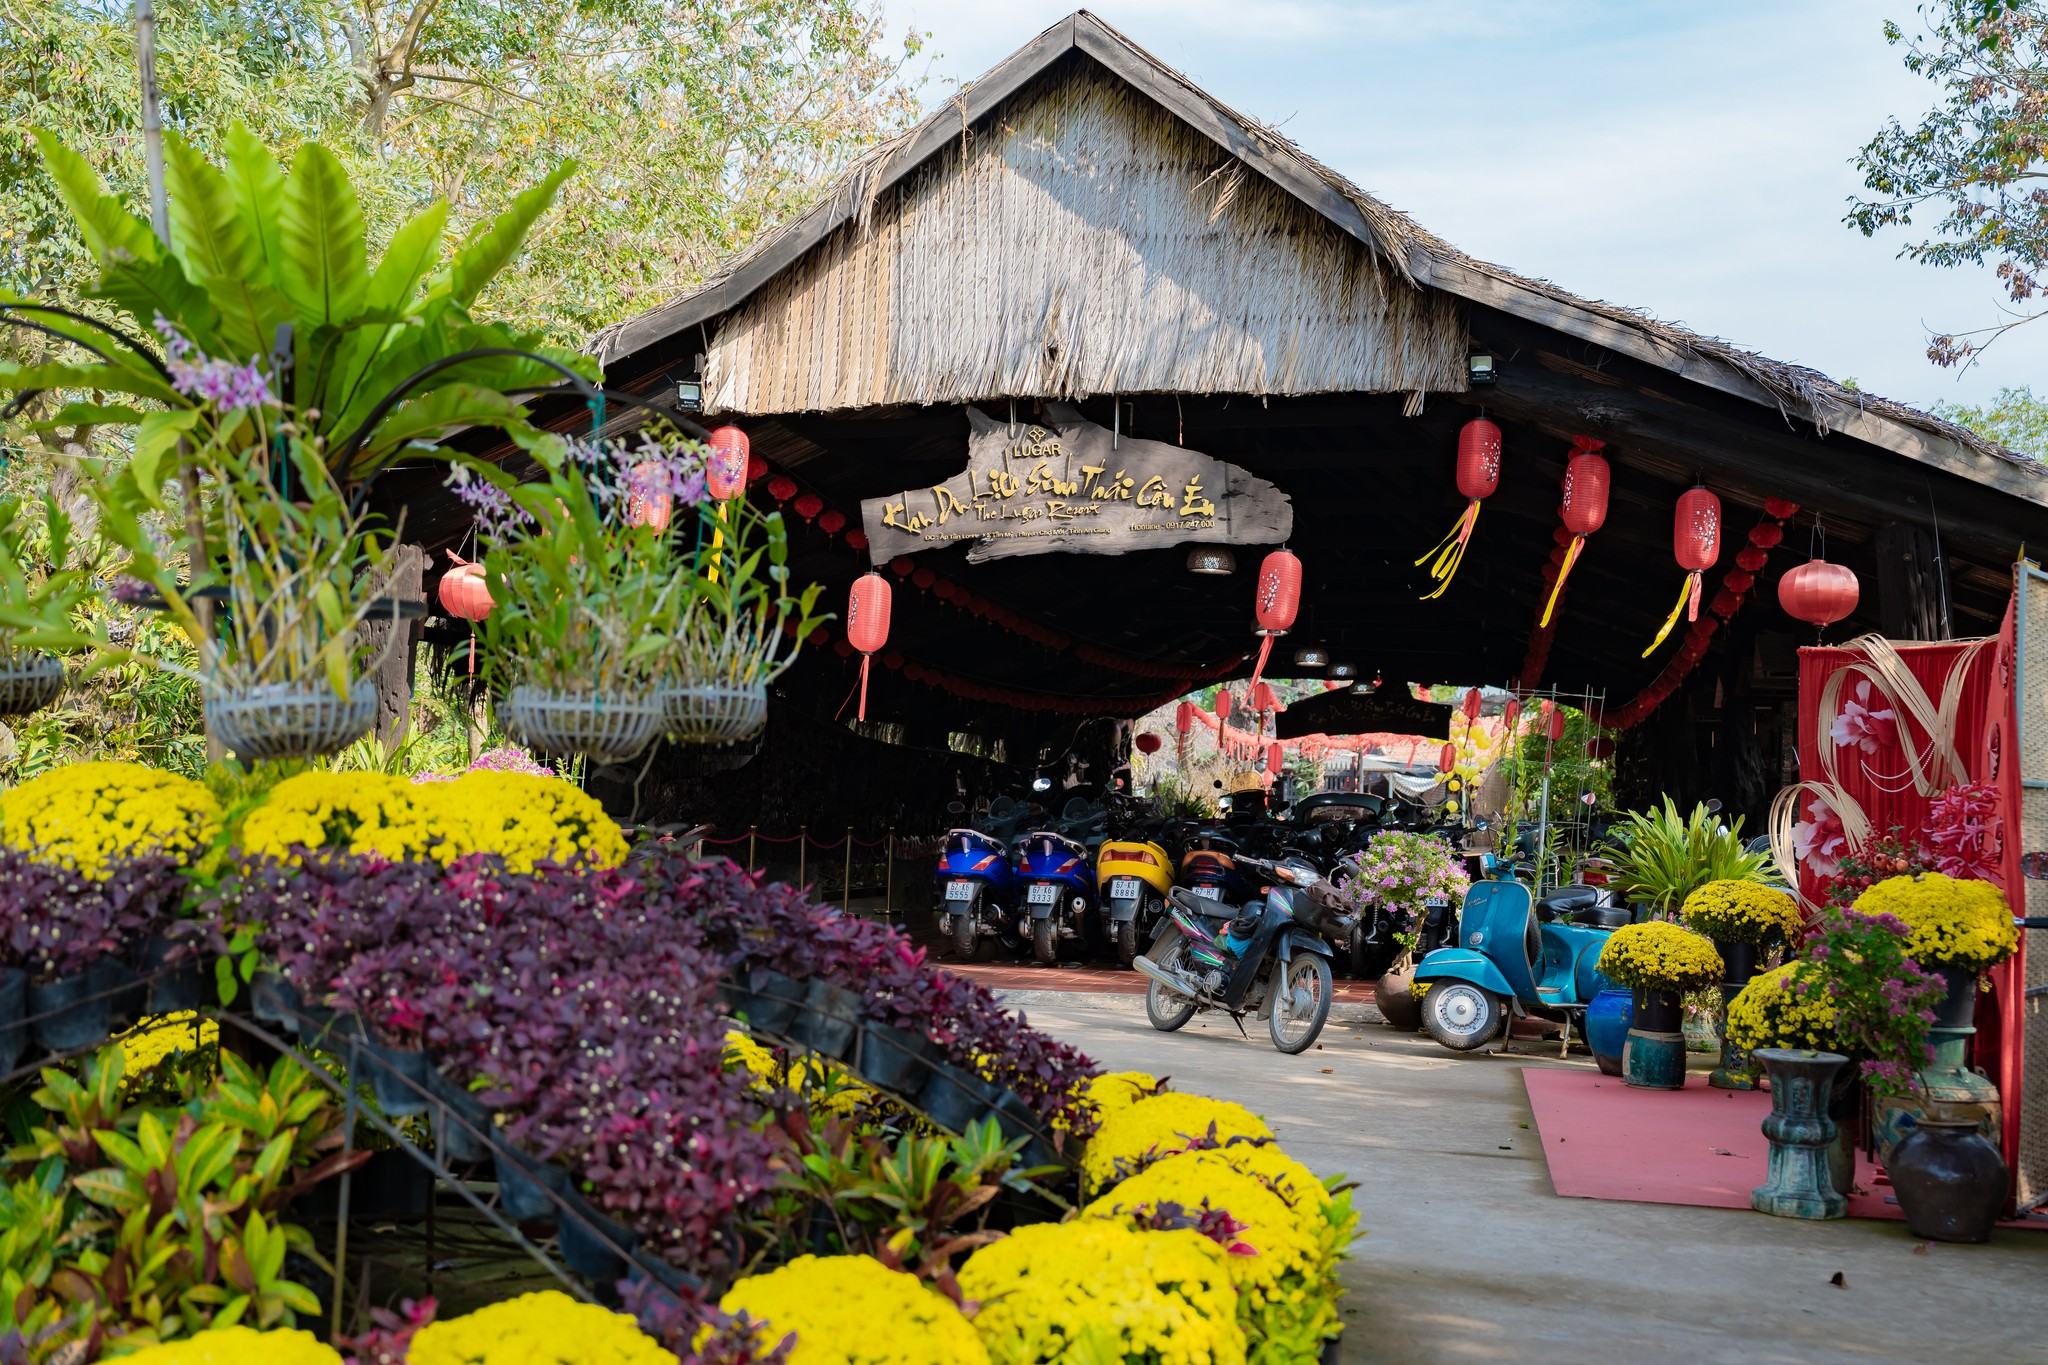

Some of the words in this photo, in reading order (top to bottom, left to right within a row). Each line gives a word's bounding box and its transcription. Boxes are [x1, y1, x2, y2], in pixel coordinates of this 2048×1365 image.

[1013, 443, 1061, 457] LUGAR
[883, 490, 937, 534] Khu
[932, 485, 972, 525] Du
[970, 448, 1020, 501] Lịch
[1026, 452, 1078, 497] Sinh
[1081, 458, 1135, 500] Thái
[975, 499, 998, 521] The
[1001, 504, 1043, 524] Lugar
[1046, 500, 1102, 520] Resort
[1165, 521, 1184, 529] 0917
[1200, 519, 1215, 528] 000
[950, 883, 970, 891] 67-K6
[1116, 881, 1135, 889] 67-K1
[1032, 886, 1052, 894] 67-K6
[1114, 888, 1135, 897] 8888
[1195, 887, 1215, 896] 67-H7
[949, 891, 969, 899] 5555
[1031, 894, 1052, 902] 3333
